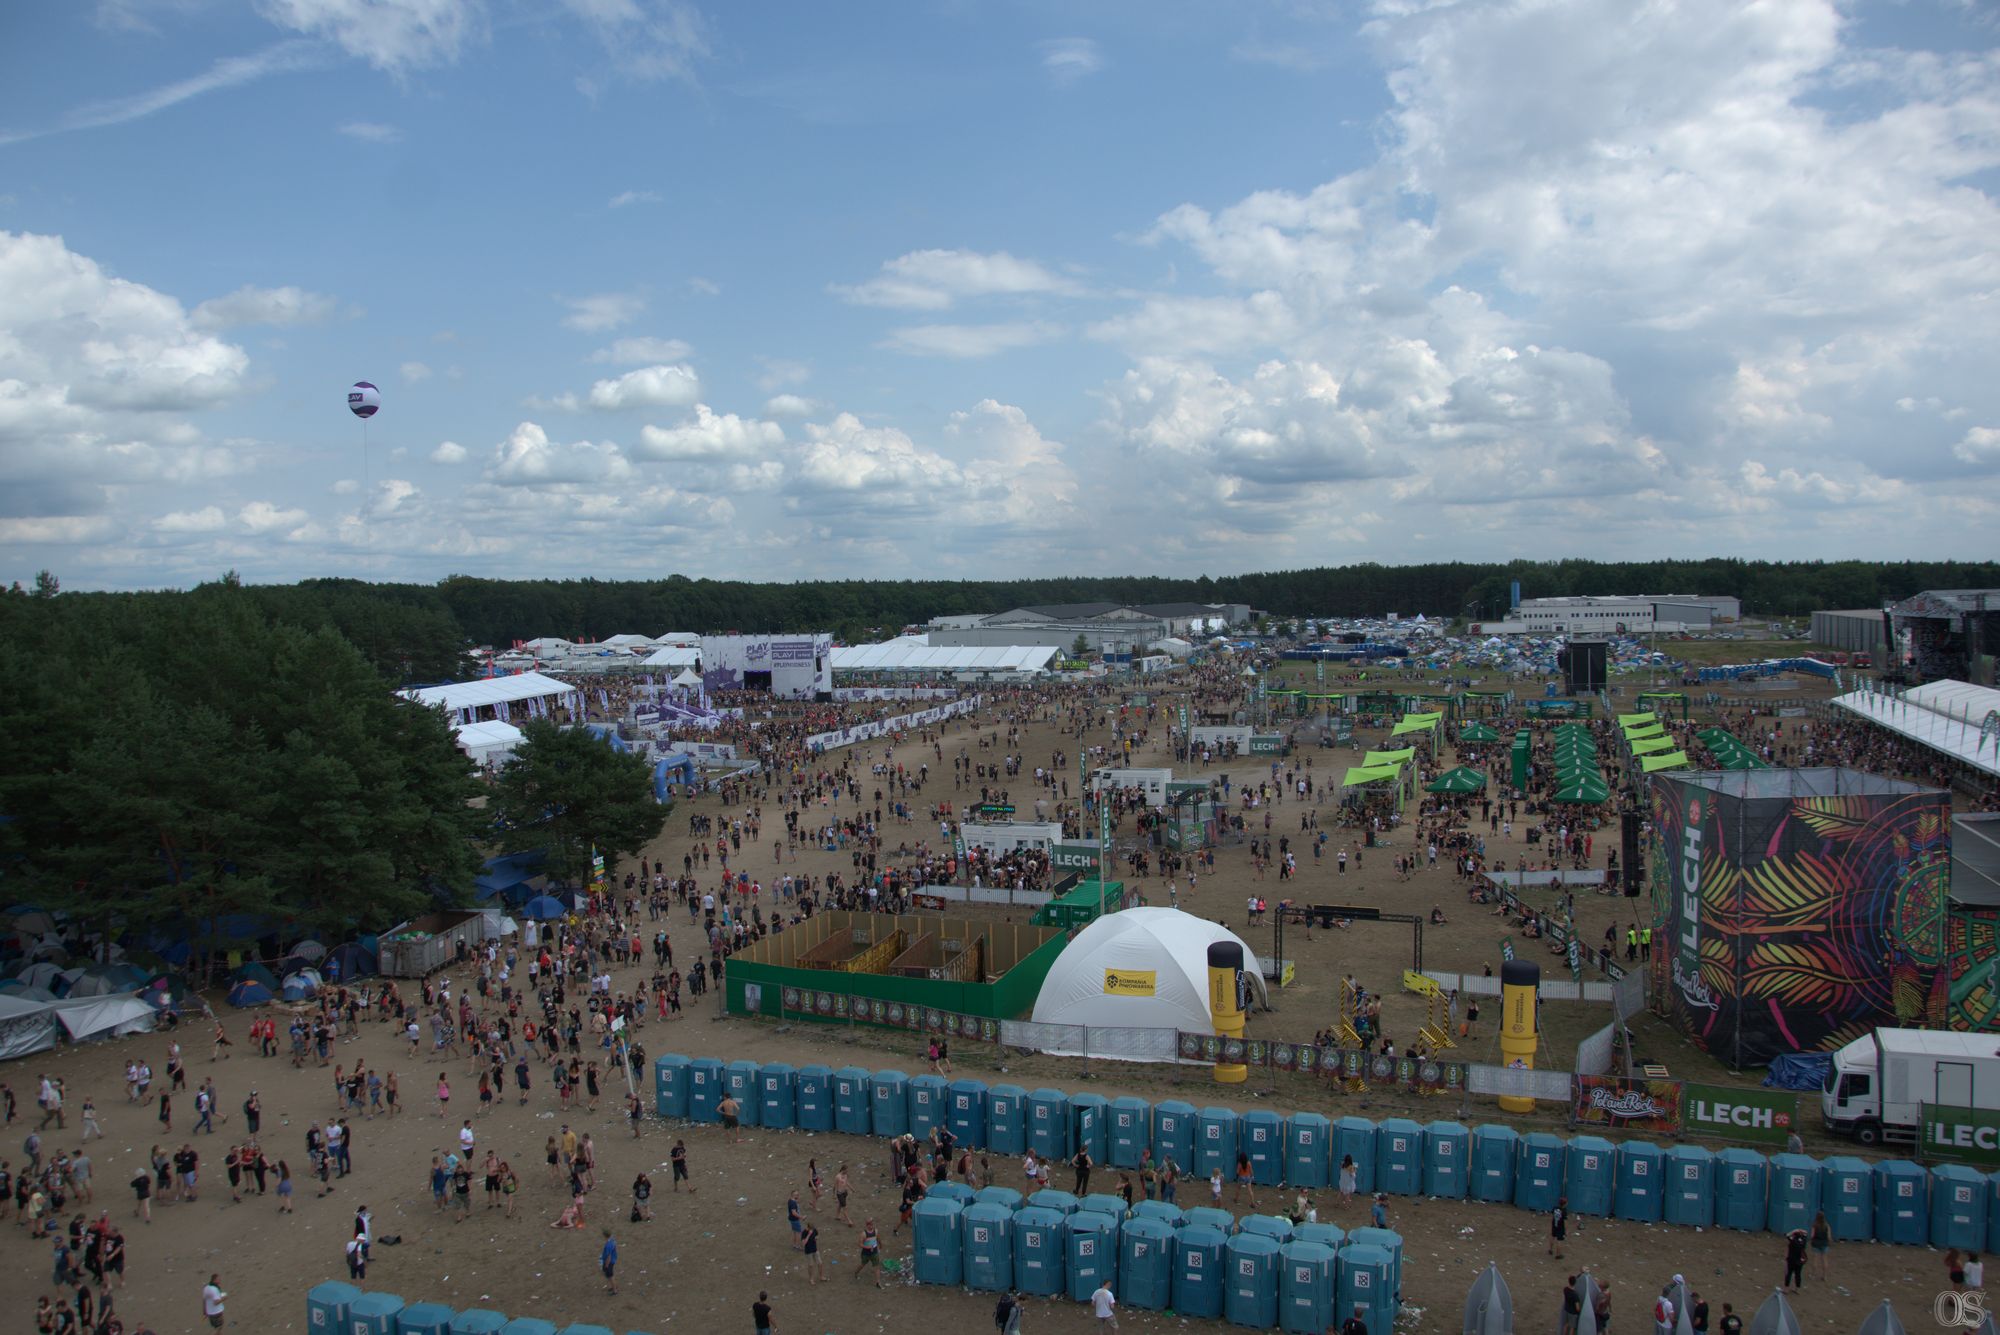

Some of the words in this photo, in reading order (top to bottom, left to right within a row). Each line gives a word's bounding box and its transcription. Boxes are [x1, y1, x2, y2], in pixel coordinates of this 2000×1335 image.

[746, 642, 768, 654] PLAY
[772, 650, 792, 659] PLAY
[1252, 742, 1275, 751] LECH
[1057, 854, 1091, 867] LECH
[1683, 826, 1701, 950] LECH
[1569, 940, 1580, 973] LECH
[1697, 1100, 1772, 1128] LECH
[1935, 1122, 2000, 1150] LEC
